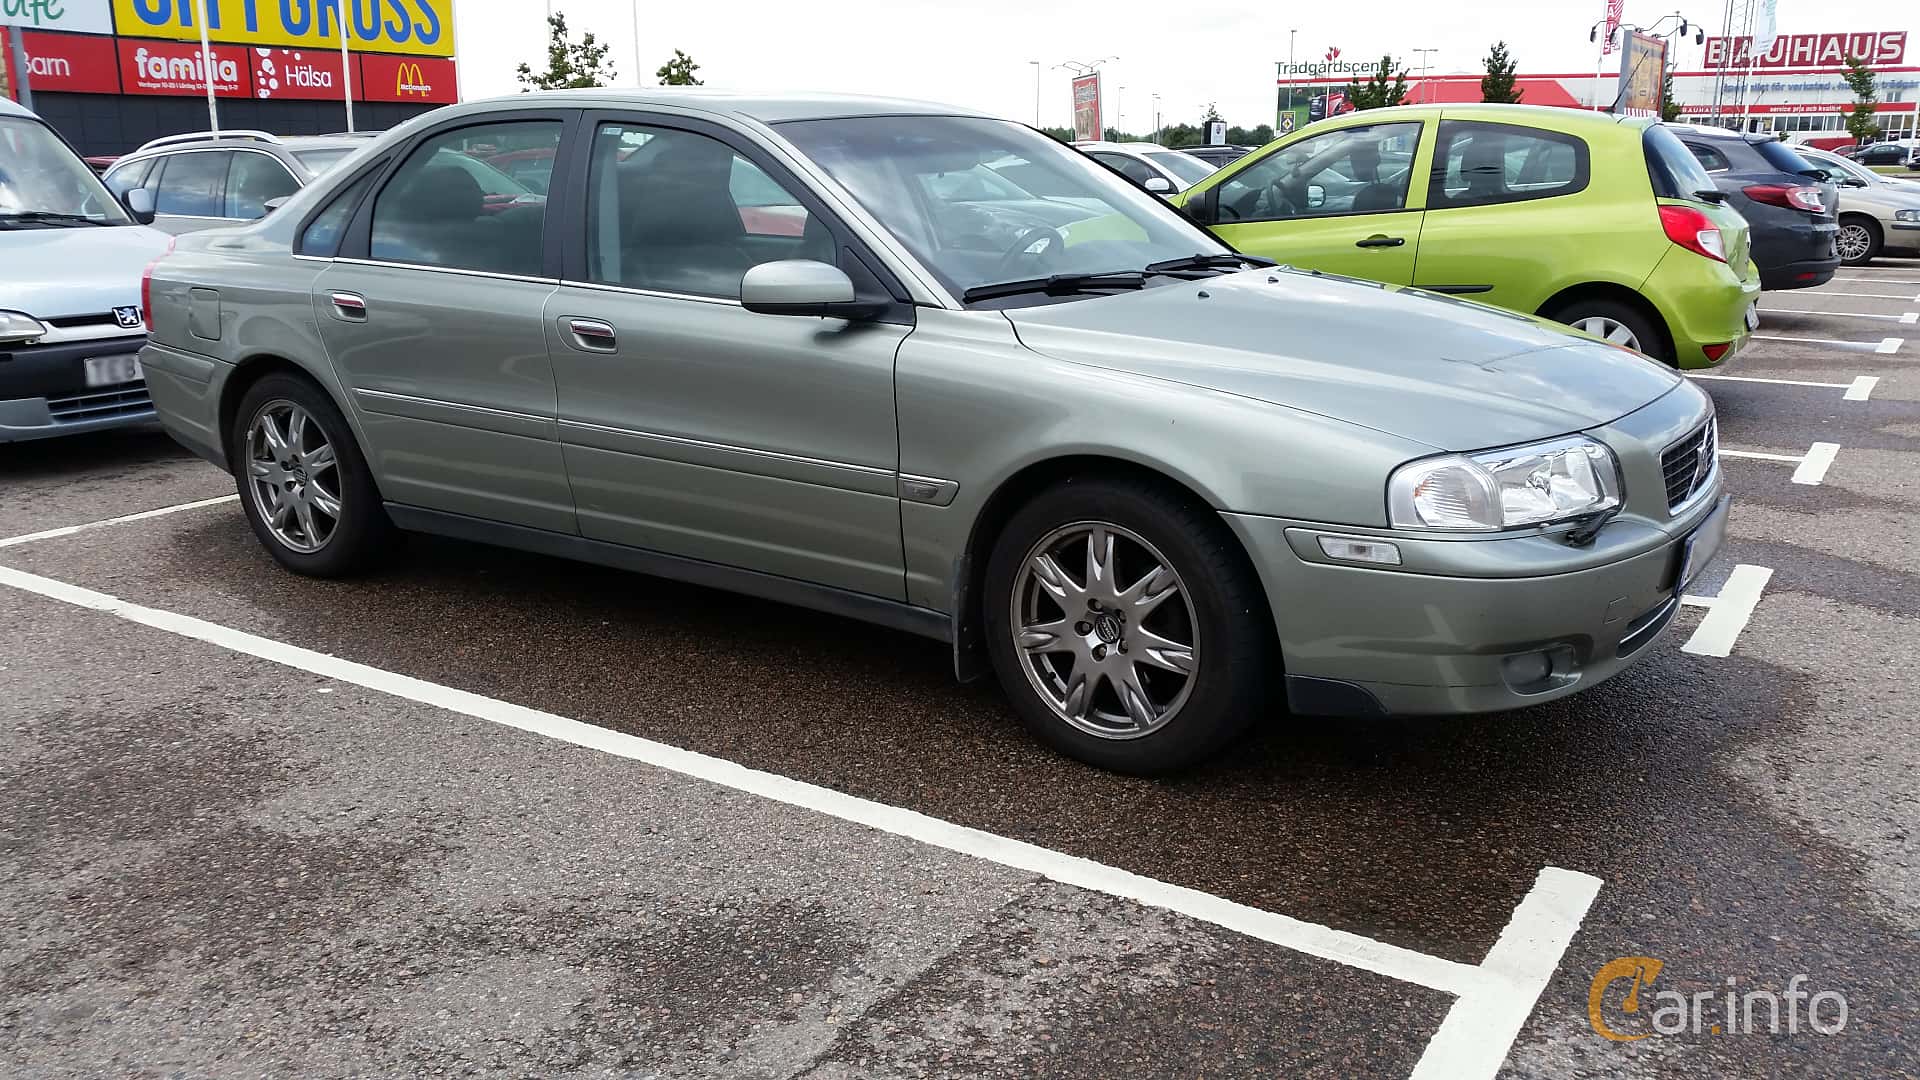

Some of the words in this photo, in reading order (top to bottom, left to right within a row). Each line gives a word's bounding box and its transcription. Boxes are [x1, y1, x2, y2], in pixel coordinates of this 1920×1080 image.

[1707, 33, 1905, 64] BAUHAUS
[135, 48, 238, 82] famiia
[286, 65, 331, 88] Hälsa
